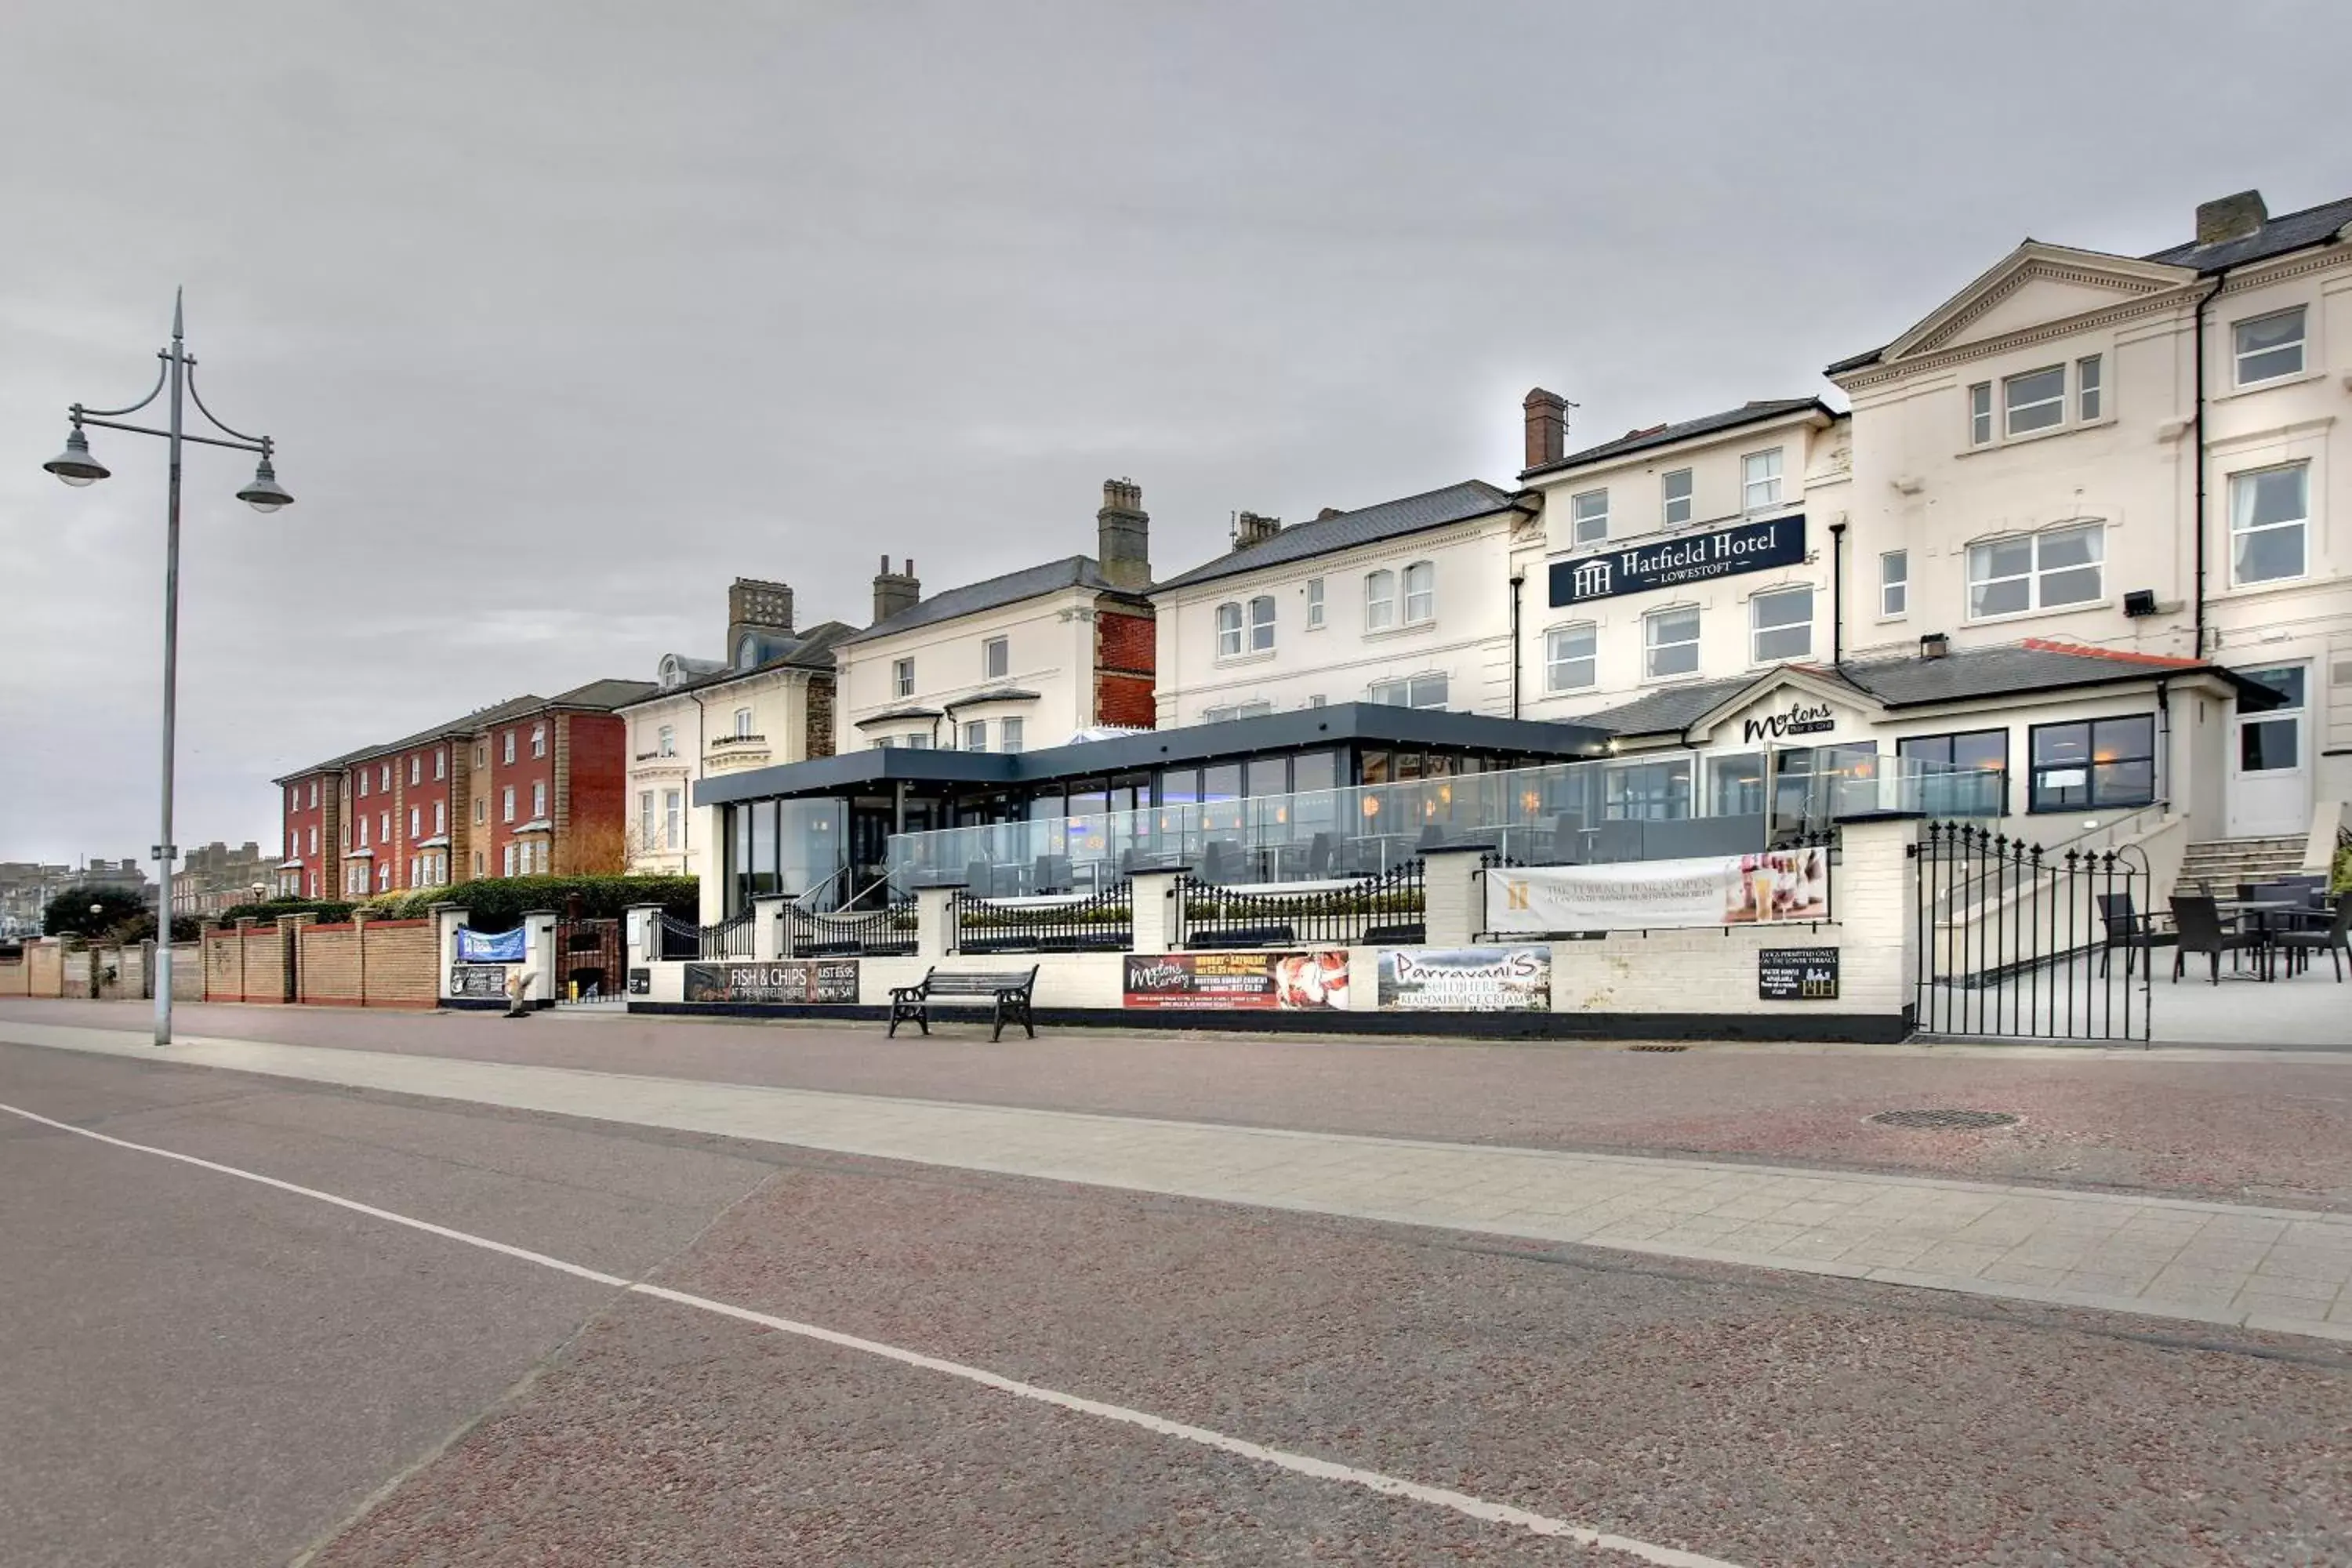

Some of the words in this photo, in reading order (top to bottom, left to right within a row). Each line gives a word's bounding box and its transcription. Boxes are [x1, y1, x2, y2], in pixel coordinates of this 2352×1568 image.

[1621, 542, 1706, 576] Hatfield
[1712, 526, 1777, 558] Hotel
[1661, 561, 1732, 583] LOWESTOFT
[1548, 885, 1568, 895] THE
[1573, 883, 1624, 894] TERRACE
[1632, 882, 1657, 892] BAR
[1675, 877, 1712, 890] OPEN
[731, 968, 756, 985] FISH
[760, 968, 768, 985] &
[771, 968, 807, 985] CHIPS
[818, 986, 835, 997] MON
[1425, 982, 1459, 992] SOLD
[1463, 982, 1496, 992] HERE
[1427, 994, 1461, 1004] DAIRY
[1463, 994, 1481, 1004] ICE
[1485, 994, 1525, 1004] CREAM
